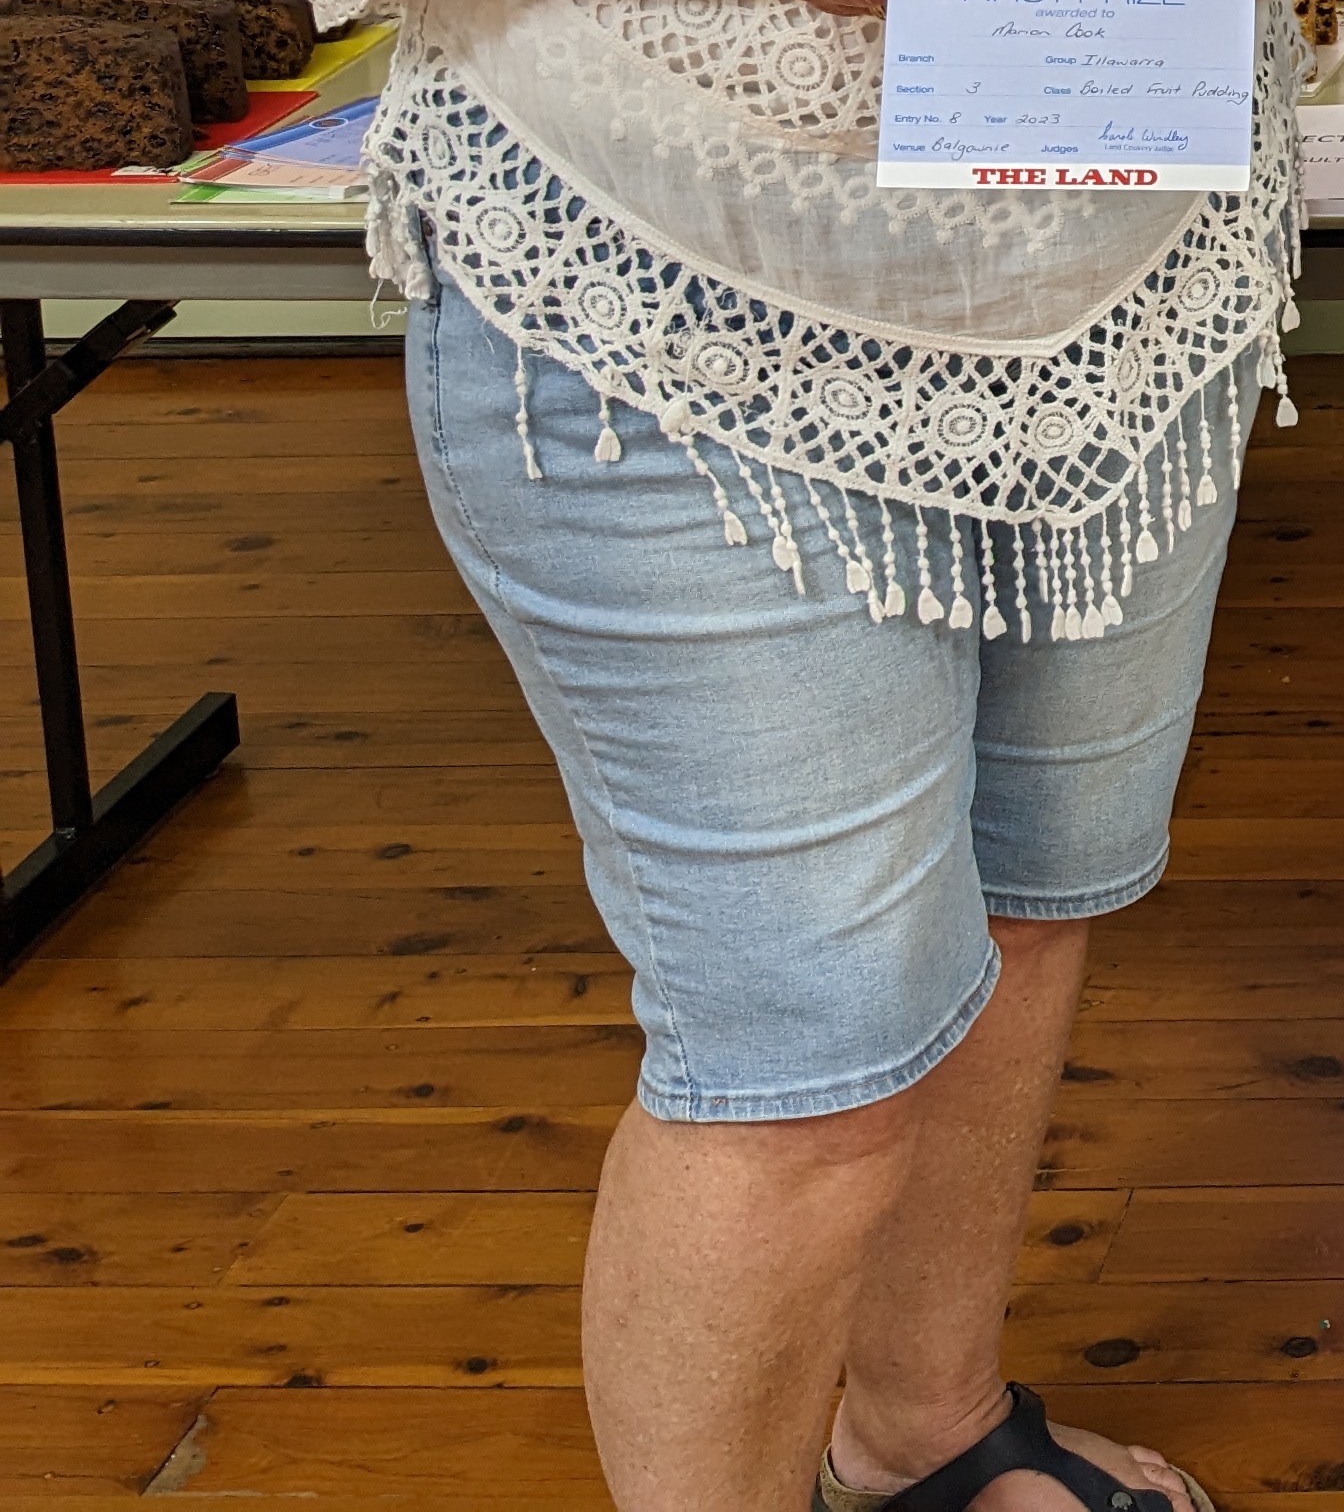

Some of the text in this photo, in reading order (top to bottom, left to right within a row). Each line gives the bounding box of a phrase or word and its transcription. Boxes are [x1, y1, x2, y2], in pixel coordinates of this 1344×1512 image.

[1035, 8, 1115, 19] awarded to
[1065, 21, 1106, 38] Cook
[898, 54, 934, 63] Branch
[1045, 56, 1077, 65] Group
[1081, 54, 1165, 67] Illawarra
[896, 85, 934, 94] Section
[965, 82, 981, 94] 3
[1043, 86, 1072, 95] Class
[1080, 80, 1249, 105] Boiled Fruit Pudding
[894, 114, 942, 125] Entry No.
[950, 112, 962, 124] 8
[984, 115, 1007, 124] Year
[1015, 113, 1061, 125] 2023
[893, 143, 926, 152] Venue
[931, 137, 1010, 161] Balgownie
[1041, 144, 1079, 154] Judges
[972, 168, 1159, 186] THE LAND
